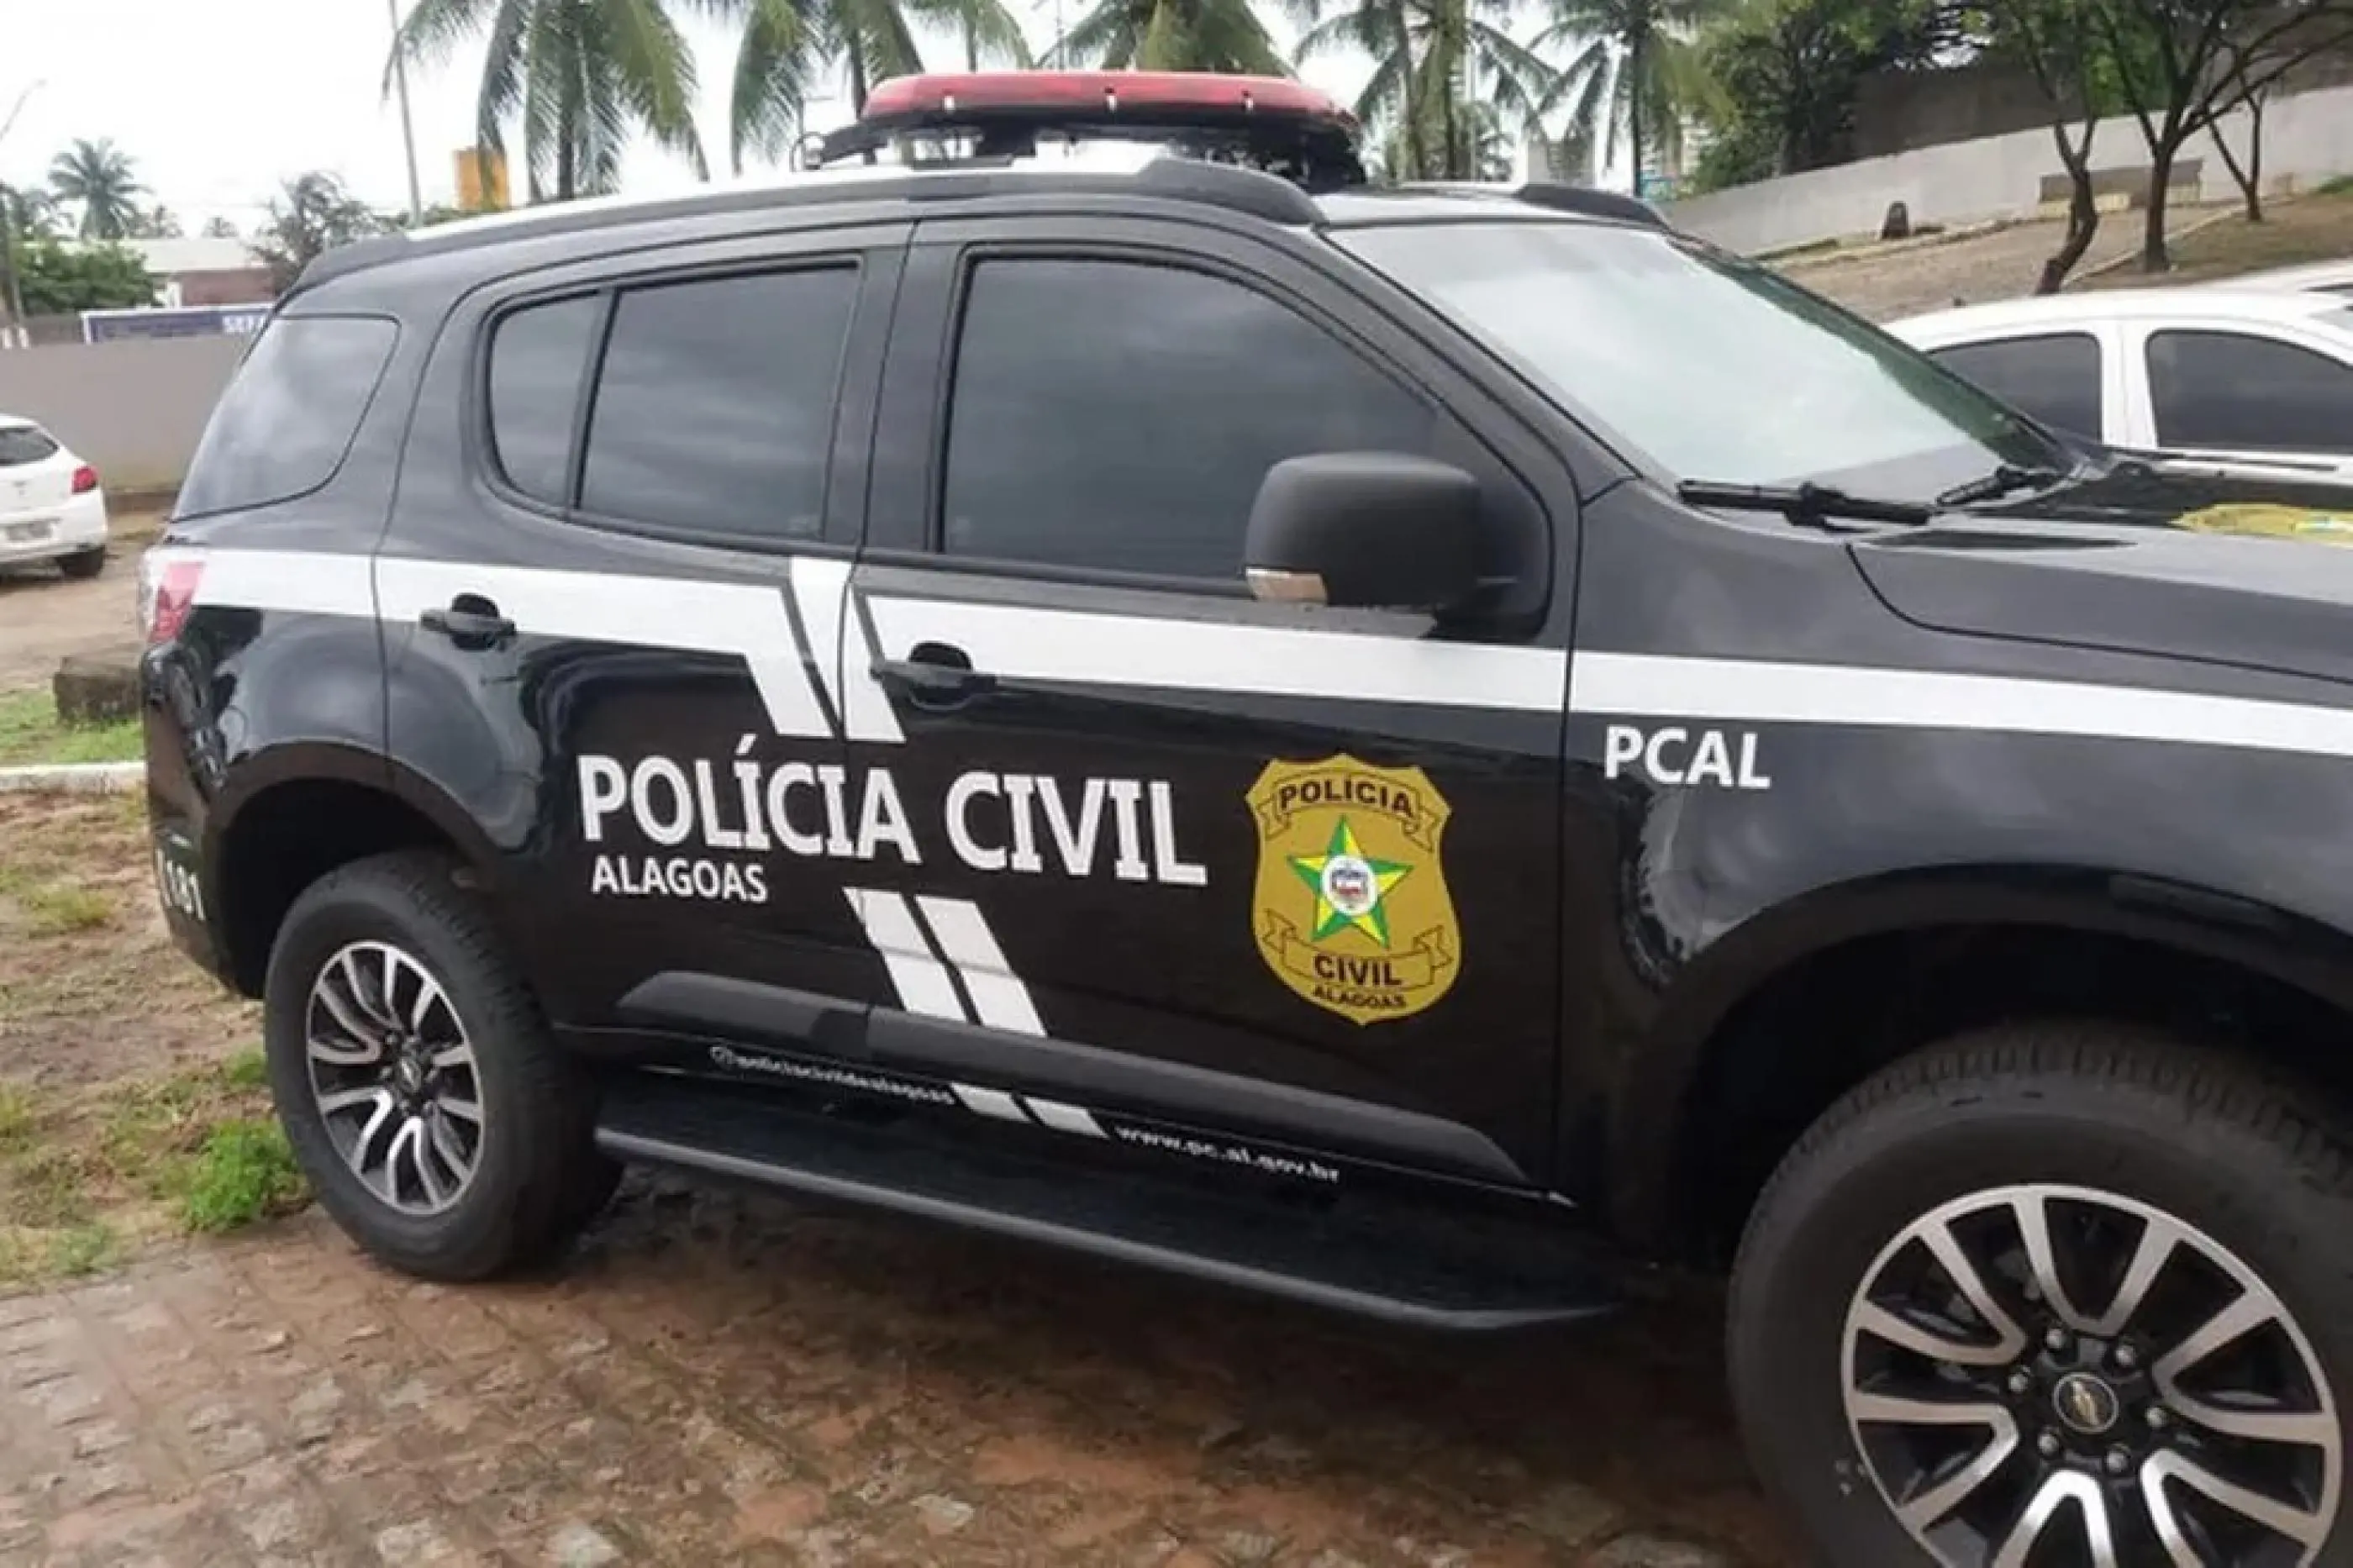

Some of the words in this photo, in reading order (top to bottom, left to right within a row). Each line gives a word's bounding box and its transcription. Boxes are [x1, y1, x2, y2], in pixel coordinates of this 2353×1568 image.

[1605, 724, 1771, 788] PCAL
[577, 734, 922, 863] POLÍCIA
[945, 771, 1207, 886] CIVIL
[592, 855, 766, 902] ALAGOAS
[1313, 955, 1403, 987] CIVIL
[1313, 985, 1407, 1009] ALAGOAS
